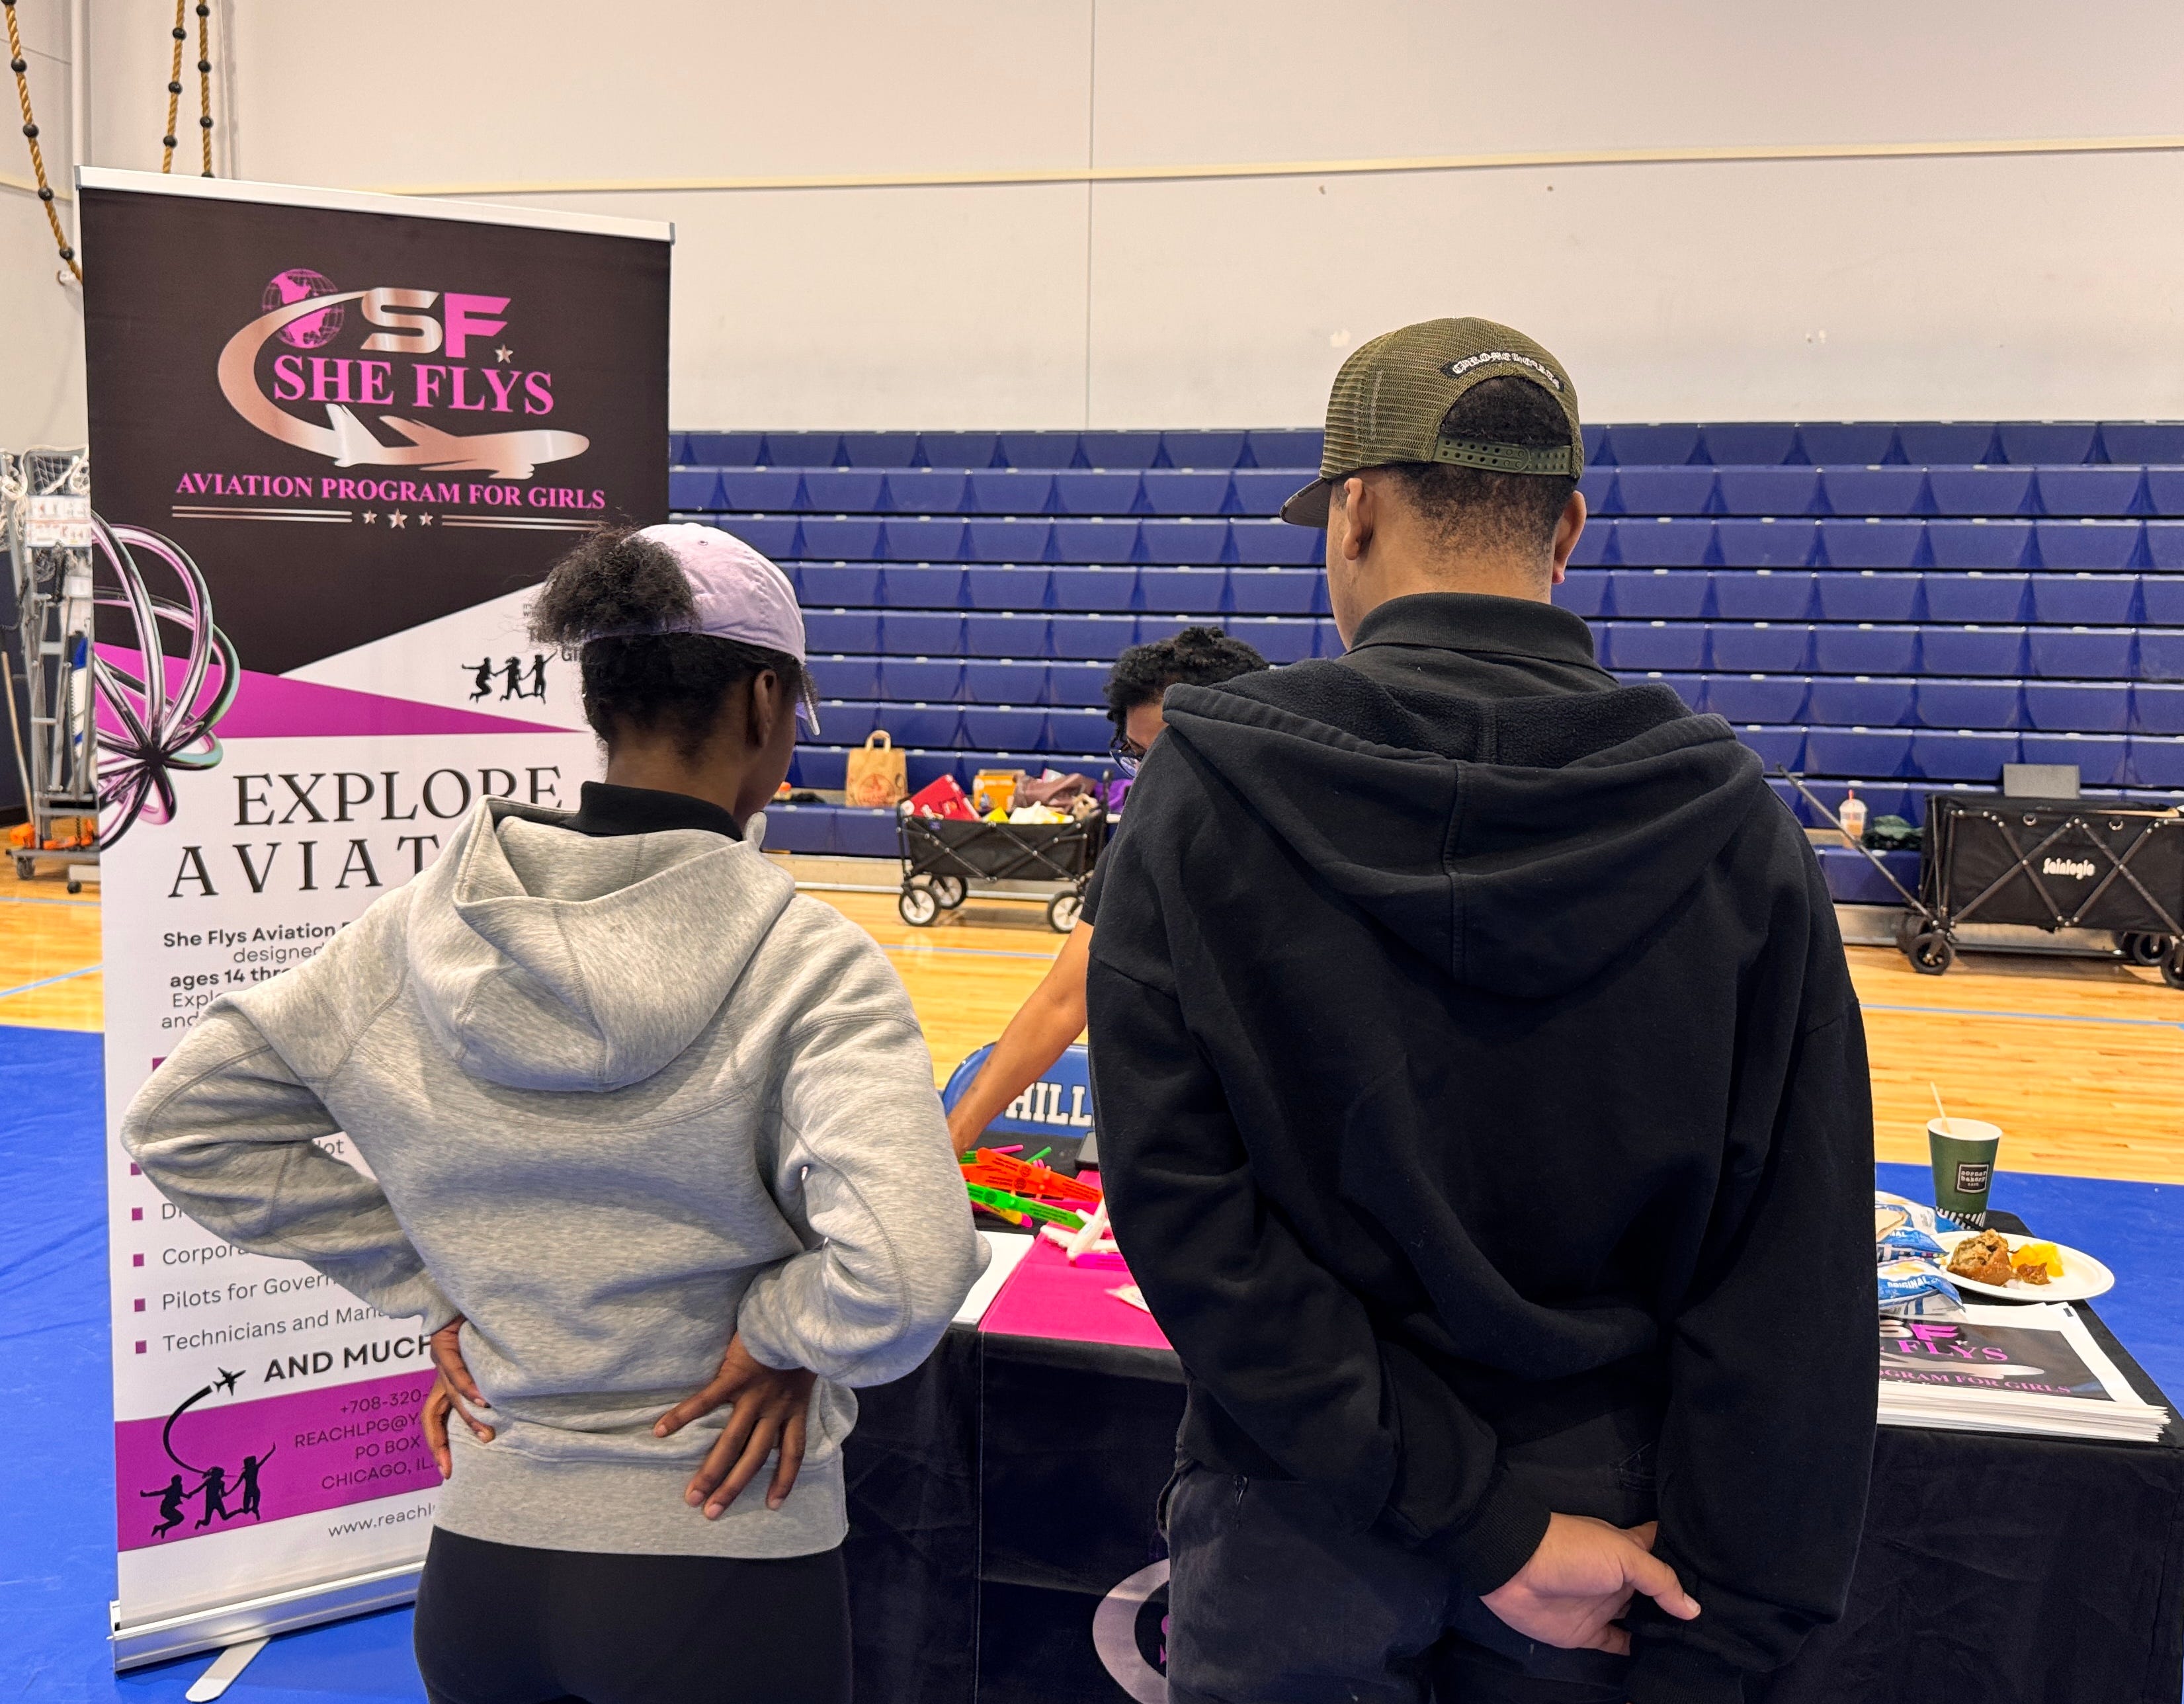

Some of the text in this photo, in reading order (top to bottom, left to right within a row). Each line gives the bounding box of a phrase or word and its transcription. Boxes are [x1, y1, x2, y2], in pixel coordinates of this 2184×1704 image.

[360, 287, 512, 358] SF
[273, 354, 554, 416] SHE FLYS
[176, 472, 606, 511] AVIATION PROGRAM FOR GIRLS
[233, 766, 562, 827] EXPLORE
[163, 922, 336, 948] She Flys Aviation
[170, 973, 220, 991] ages
[224, 968, 245, 984] 14
[173, 990, 224, 1010] Expl
[1004, 1081, 1096, 1127] HILL
[163, 1289, 222, 1311] Pilots
[228, 1283, 258, 1301] for
[1887, 1276, 1930, 1289] ORIGINAL
[163, 1320, 286, 1352] Technicians
[292, 1310, 329, 1332] and
[1898, 1340, 2008, 1361] FLYS
[264, 1350, 333, 1383] AND
[1880, 1369, 2072, 1393] GRAM FOR GIRLS
[340, 1386, 432, 1414] +708-320-
[355, 1435, 421, 1459] PO BOX
[321, 1460, 412, 1490] CHICAGO,
[328, 1502, 436, 1537] www.reachl
